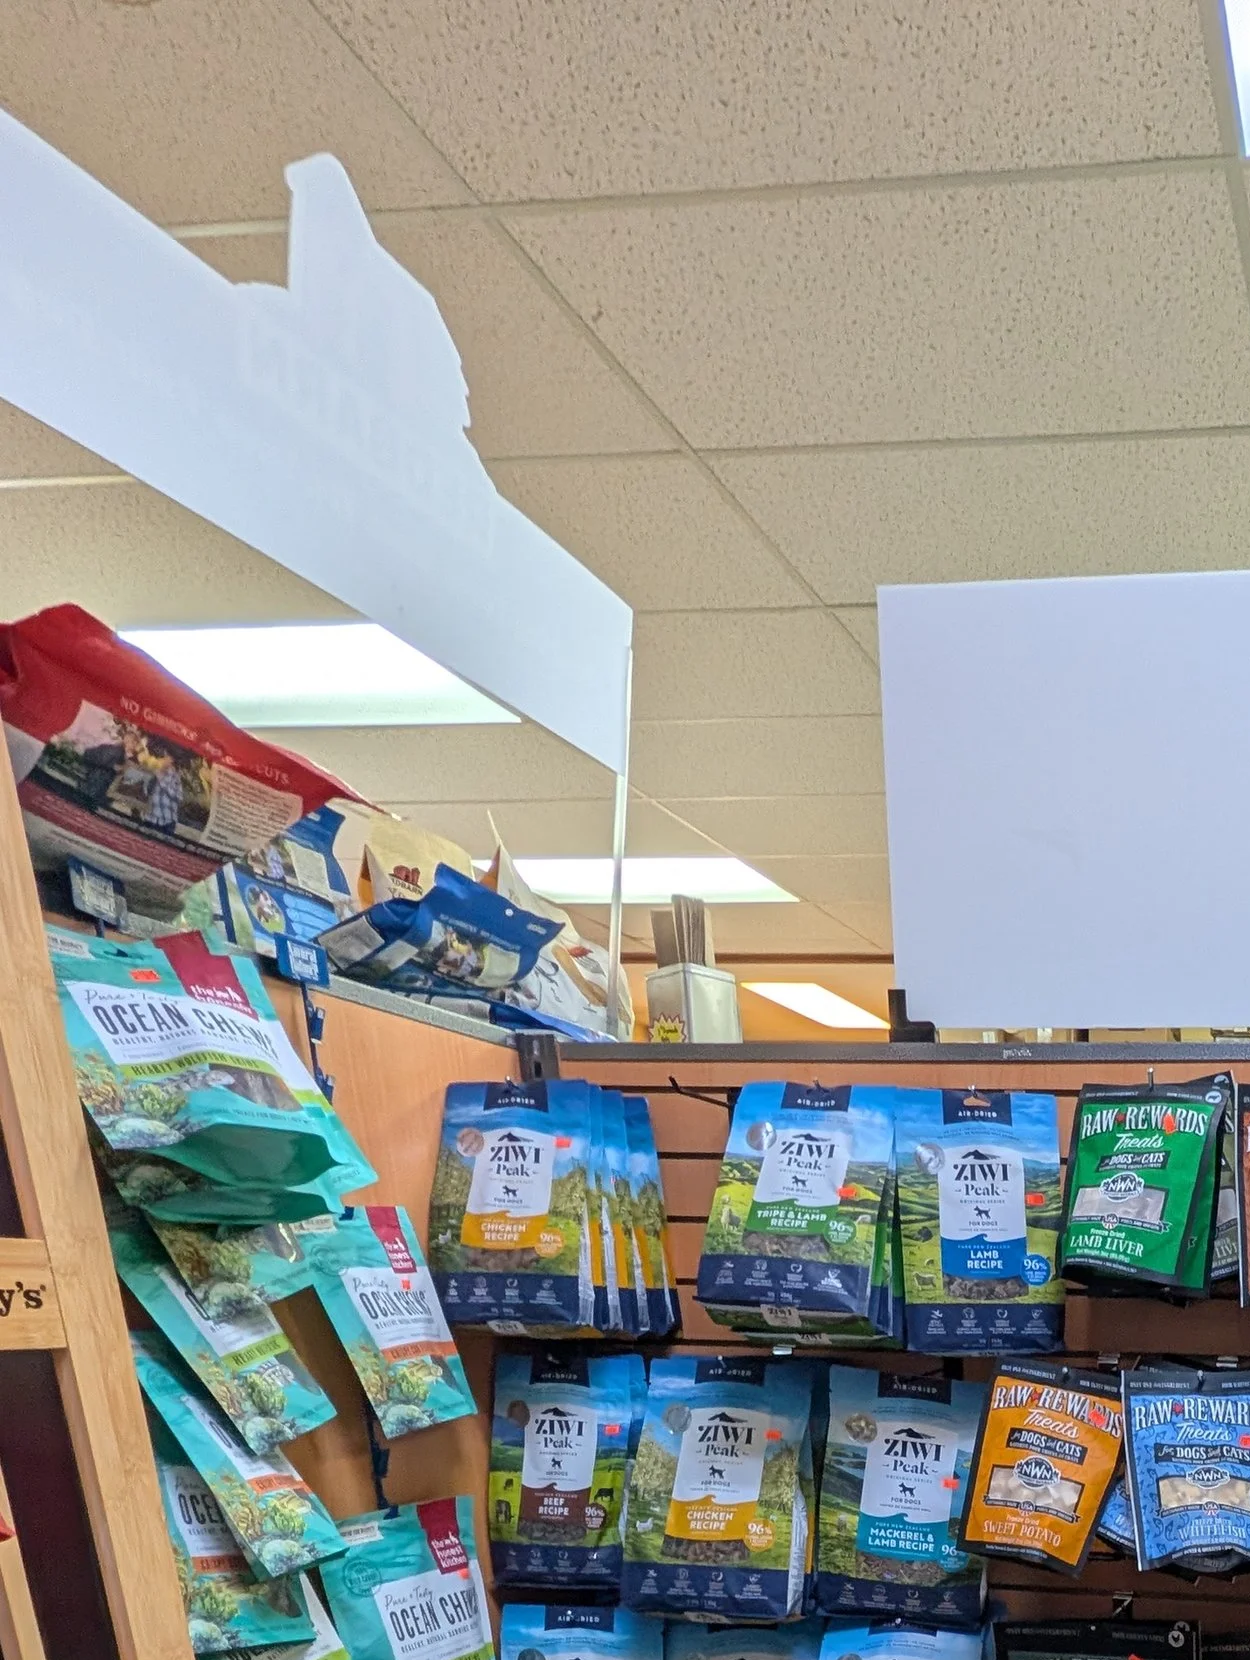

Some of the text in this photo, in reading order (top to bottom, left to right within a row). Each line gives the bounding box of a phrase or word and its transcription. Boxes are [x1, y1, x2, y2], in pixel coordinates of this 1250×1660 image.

[952, 1162, 1011, 1182] ZIWI
[963, 1182, 1000, 1196] Peak
[757, 1209, 827, 1222] TRIPE & LAMB
[480, 1223, 526, 1234] CHICKEN
[1070, 1235, 1144, 1258] LAMB LIVER
[970, 1249, 999, 1259] LAMB
[966, 1259, 1003, 1270] RECIPE
[1023, 1258, 1048, 1271] 96%
[1134, 1399, 1173, 1431] RAW
[884, 1438, 945, 1462] ZIWI
[892, 1461, 929, 1477] Peak
[543, 1497, 565, 1506] BEEF
[538, 1506, 570, 1516] RECIPE
[687, 1510, 734, 1522] CHICKEN
[689, 1519, 726, 1531] RECIPE
[870, 1527, 934, 1542] MACKEREL &
[983, 1519, 1062, 1547] SWEET POTATO
[1178, 1524, 1246, 1541] WHITEFISH
[868, 1536, 935, 1552] LAMB RECIPE
[389, 1600, 440, 1642] OCEAN
